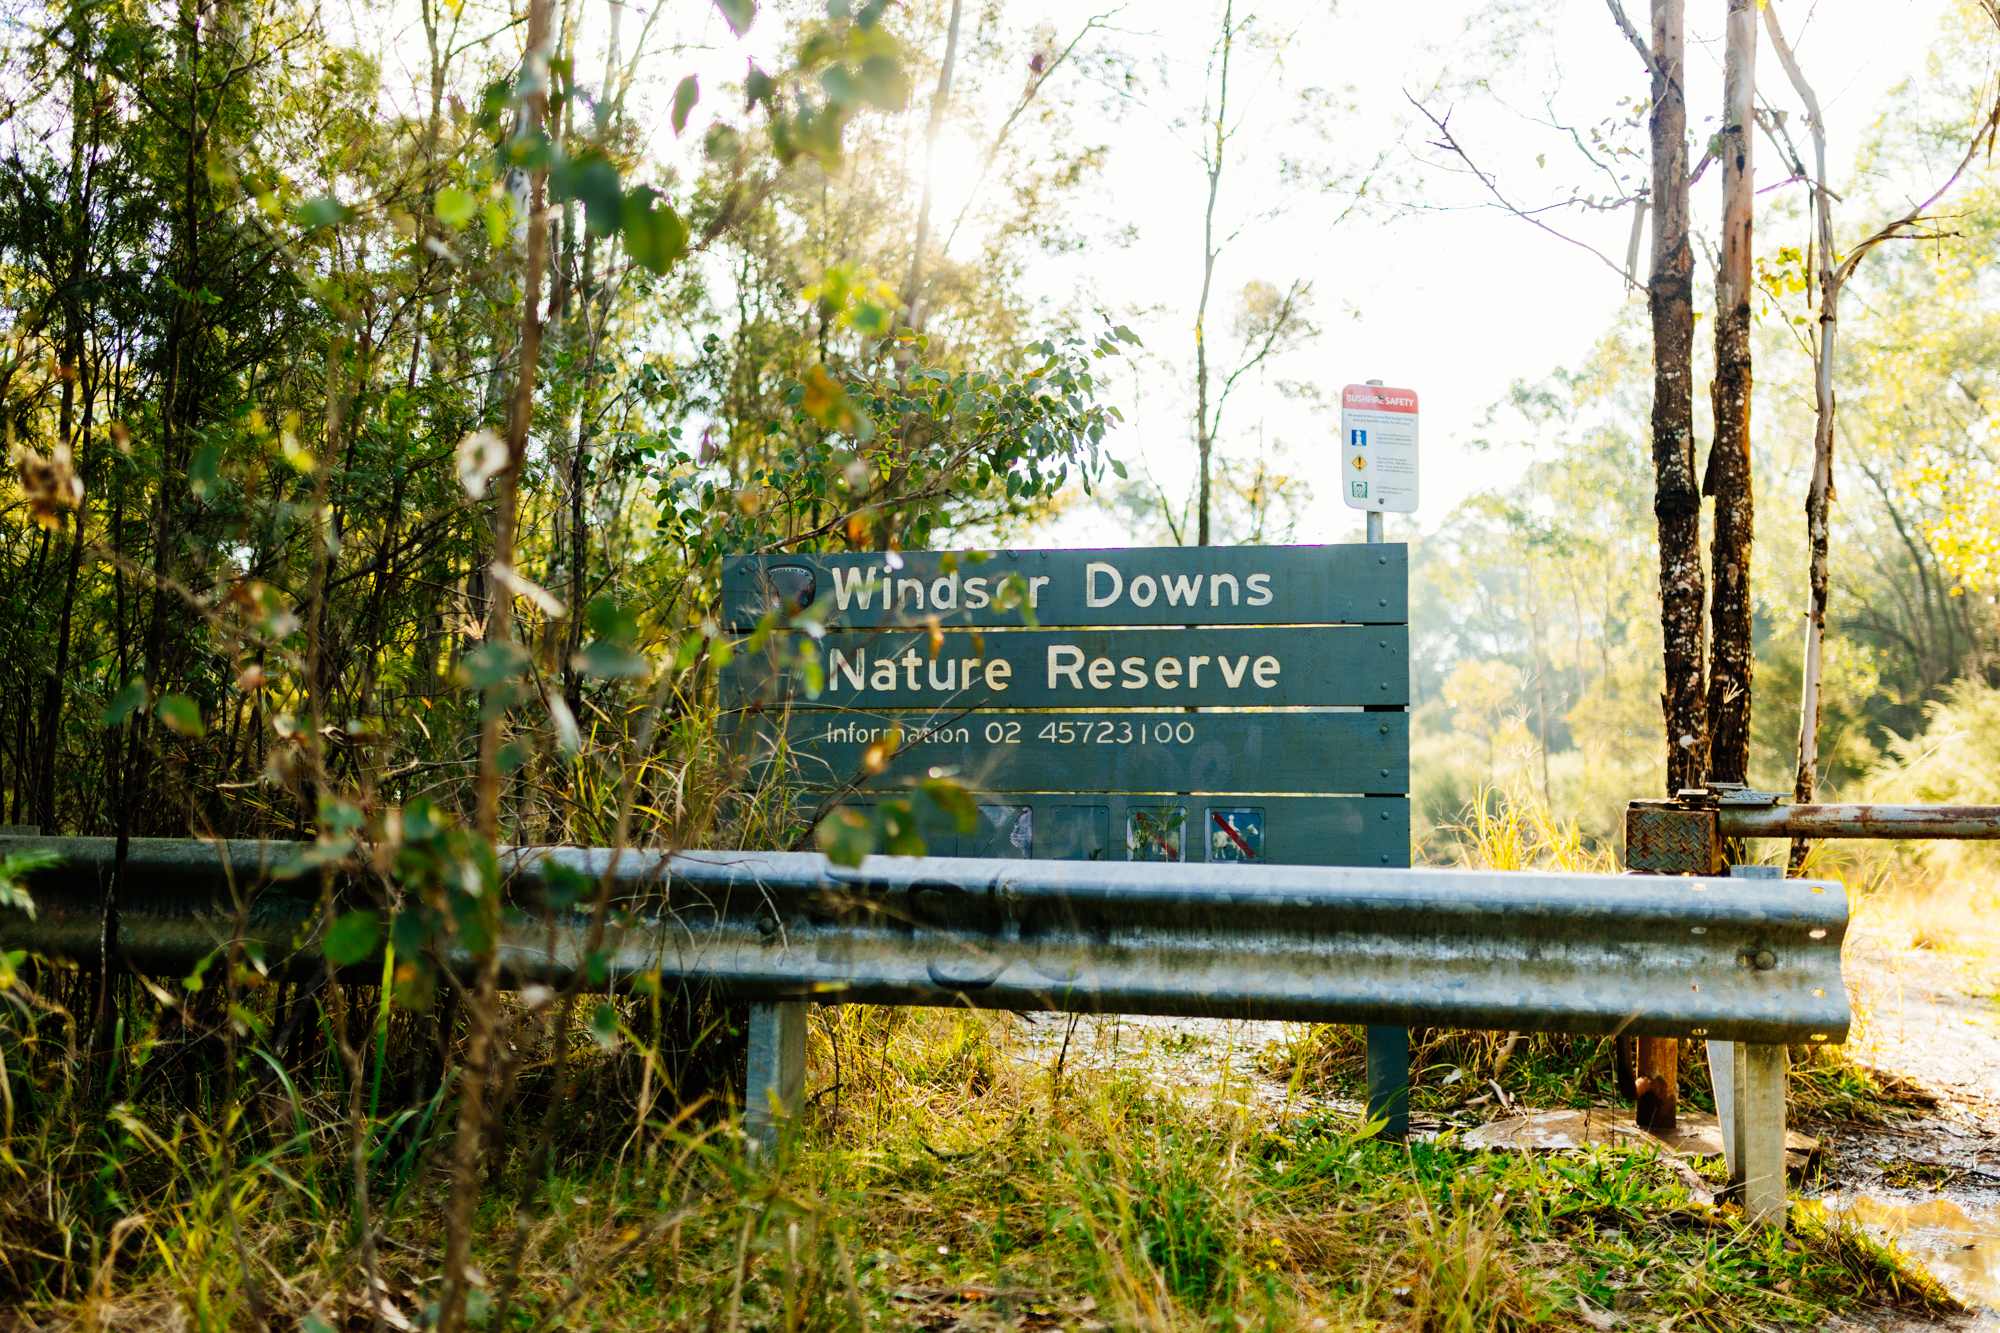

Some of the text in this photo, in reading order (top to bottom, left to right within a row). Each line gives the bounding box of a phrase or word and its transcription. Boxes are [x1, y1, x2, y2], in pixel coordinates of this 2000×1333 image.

[1385, 396, 1415, 407] SAFETY
[1086, 562, 1274, 608] Downs
[829, 644, 1281, 692] Nature Reserve
[984, 721, 1022, 744] 02
[1038, 721, 1195, 745] 45723100
